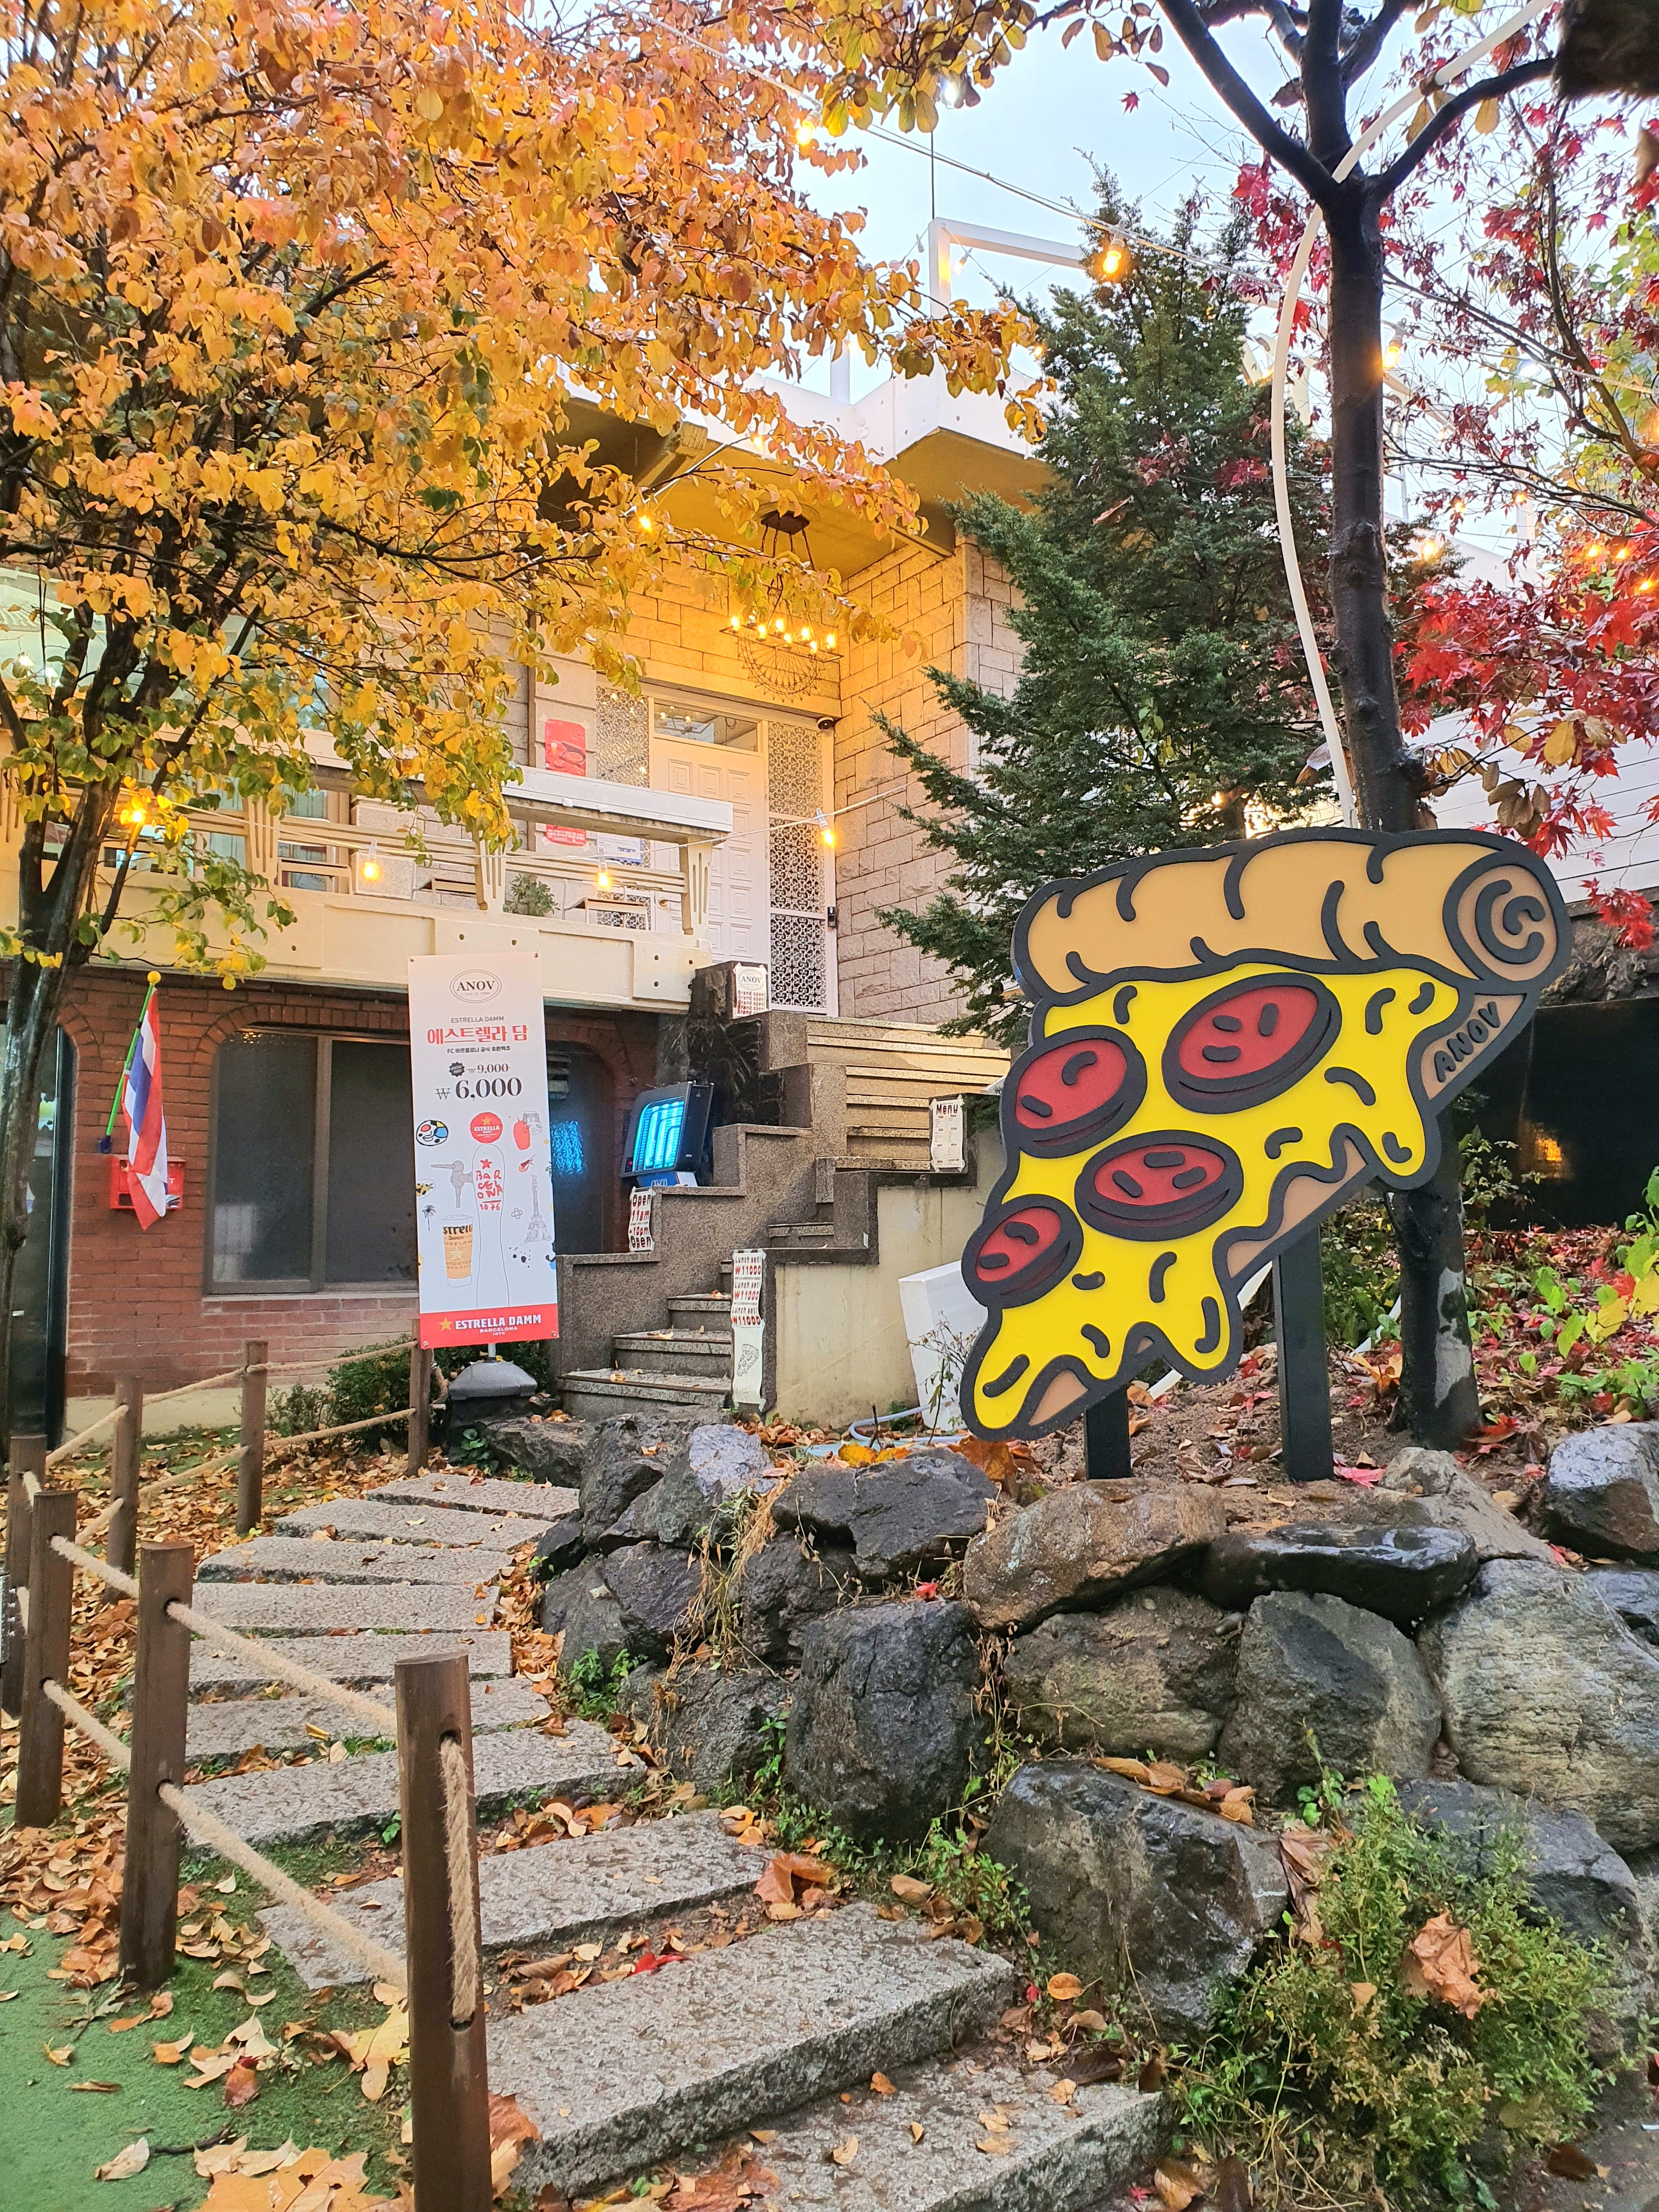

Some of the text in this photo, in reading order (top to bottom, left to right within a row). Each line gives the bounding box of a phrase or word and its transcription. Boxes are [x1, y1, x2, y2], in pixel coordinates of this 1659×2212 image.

[456, 980, 495, 991] ANOV
[427, 1025, 528, 1044] 에스트렐라 담
[1434, 1001, 1500, 1083] ANOV
[936, 1104, 958, 1115] Menu
[633, 1194, 651, 1208] Open
[631, 1210, 650, 1222] 11am
[631, 1235, 651, 1249] Open
[455, 1314, 541, 1330] ESTRELLA DAMM
